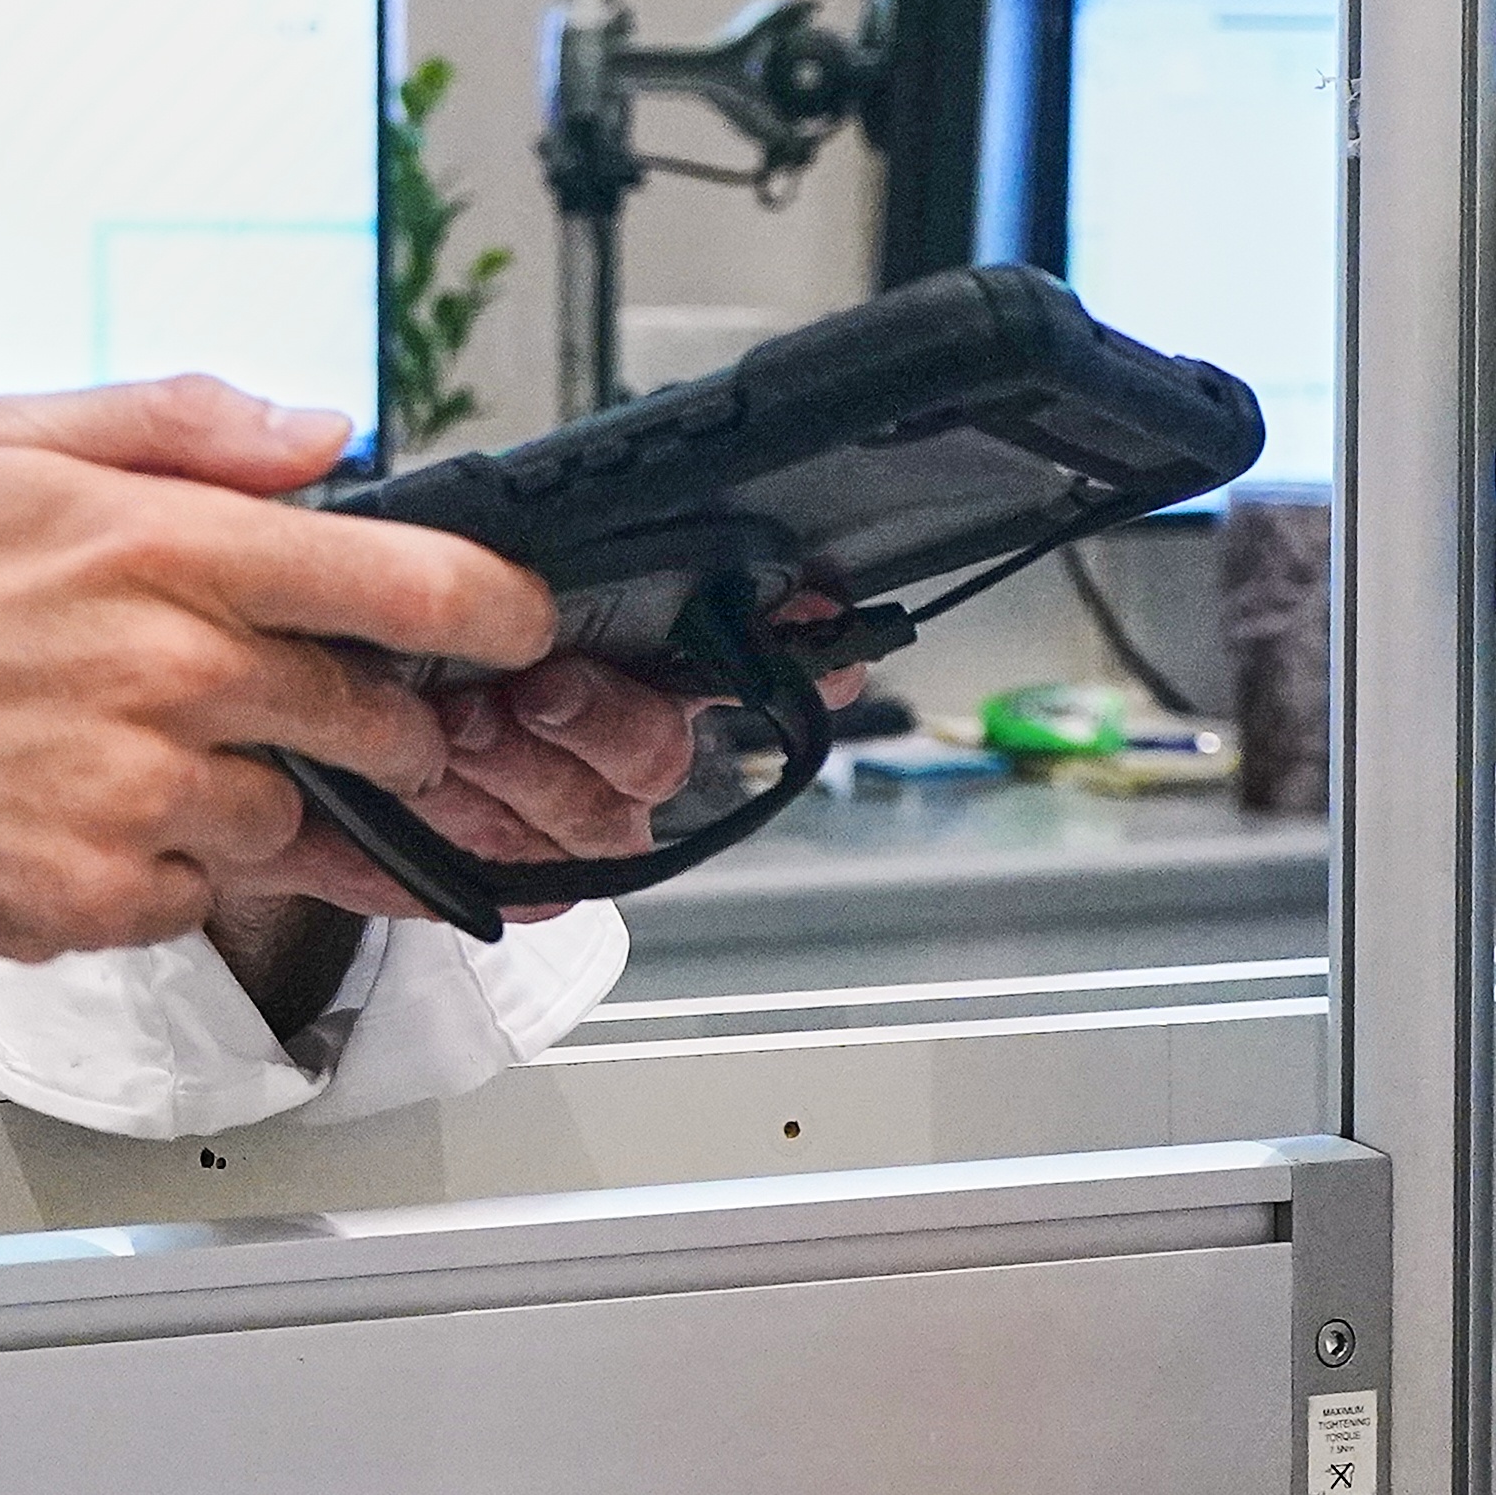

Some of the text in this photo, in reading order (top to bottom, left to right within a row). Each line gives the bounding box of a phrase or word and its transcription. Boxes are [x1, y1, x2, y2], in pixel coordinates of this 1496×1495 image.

[1322, 1405, 1365, 1418] MAXIMUM
[1317, 1417, 1371, 1431] TIGHTENING
[1324, 1430, 1361, 1443] TORQUE
